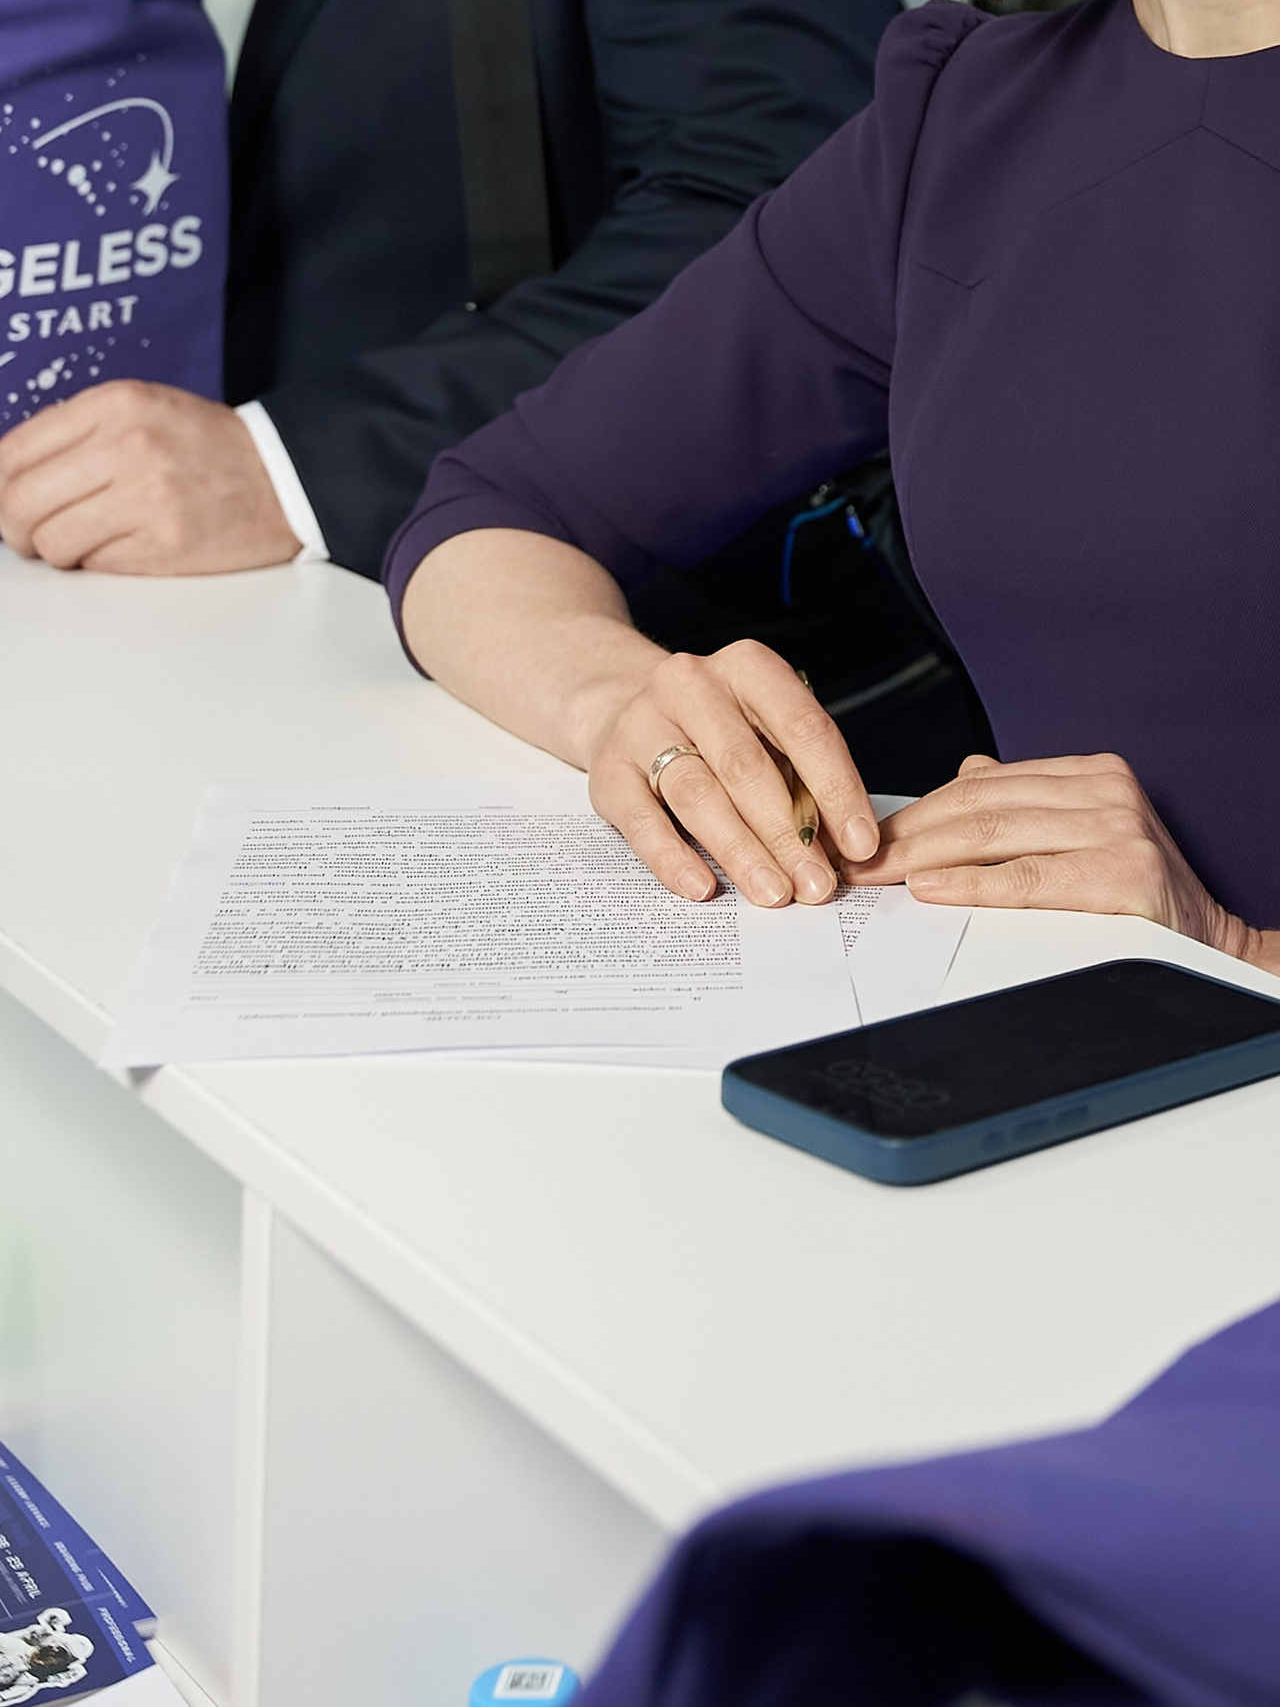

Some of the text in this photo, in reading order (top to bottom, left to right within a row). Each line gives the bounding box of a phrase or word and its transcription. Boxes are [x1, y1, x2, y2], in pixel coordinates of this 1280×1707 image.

[7, 294, 140, 342] START
[15, 1569, 42, 1600] APRIL
[97, 1606, 135, 1663] PROFESSIONAL
